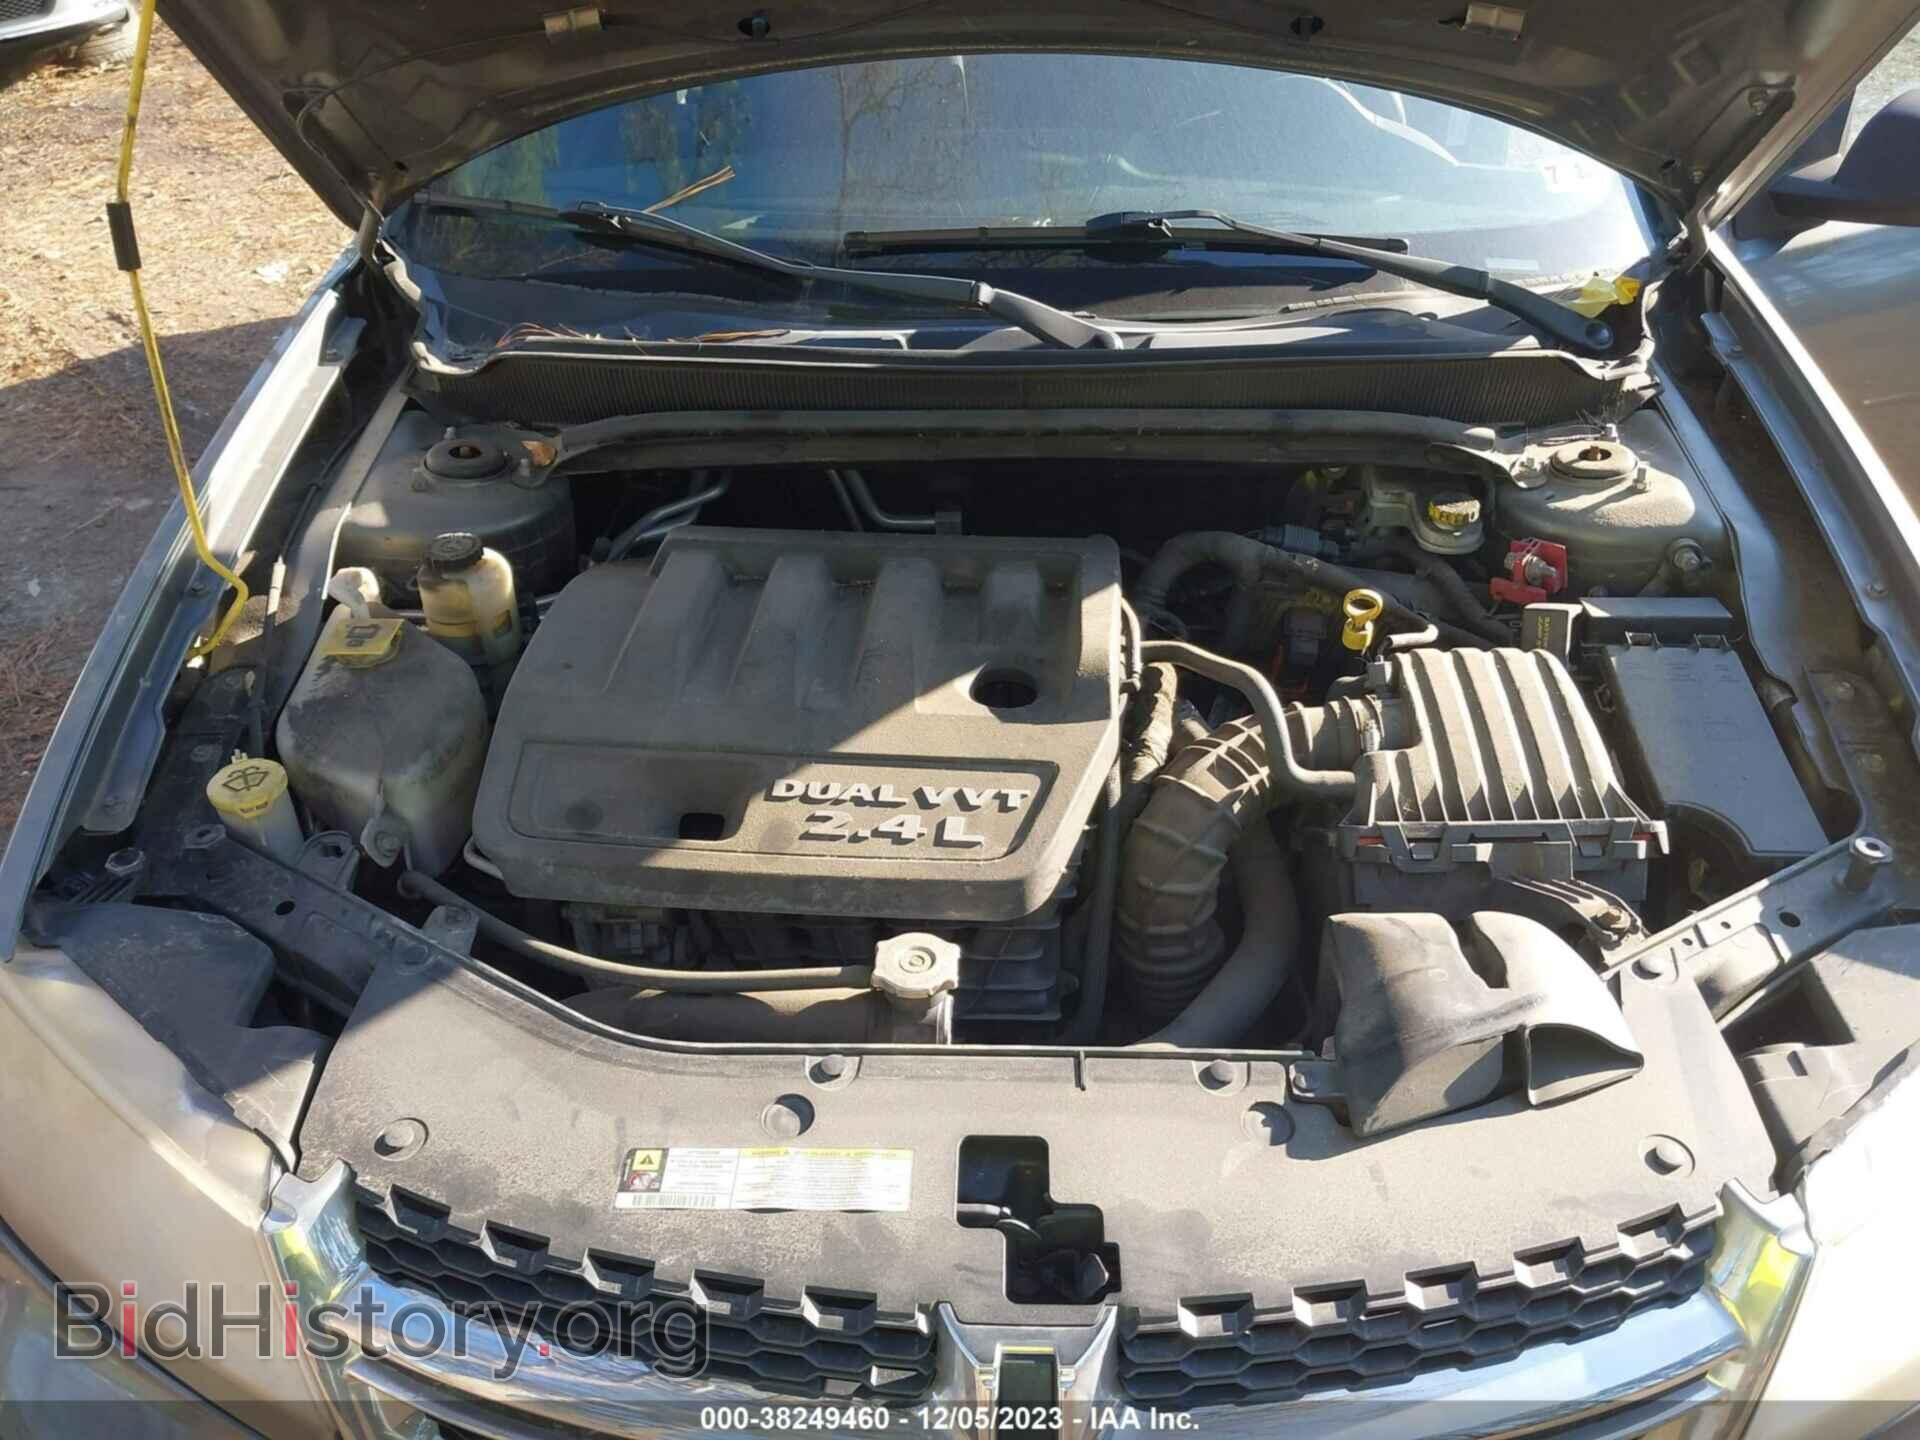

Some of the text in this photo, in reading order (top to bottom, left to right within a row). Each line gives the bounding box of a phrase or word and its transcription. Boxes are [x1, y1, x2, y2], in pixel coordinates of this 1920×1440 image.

[766, 778, 1030, 812] DUAL VVT
[800, 810, 985, 847] 2.4L
